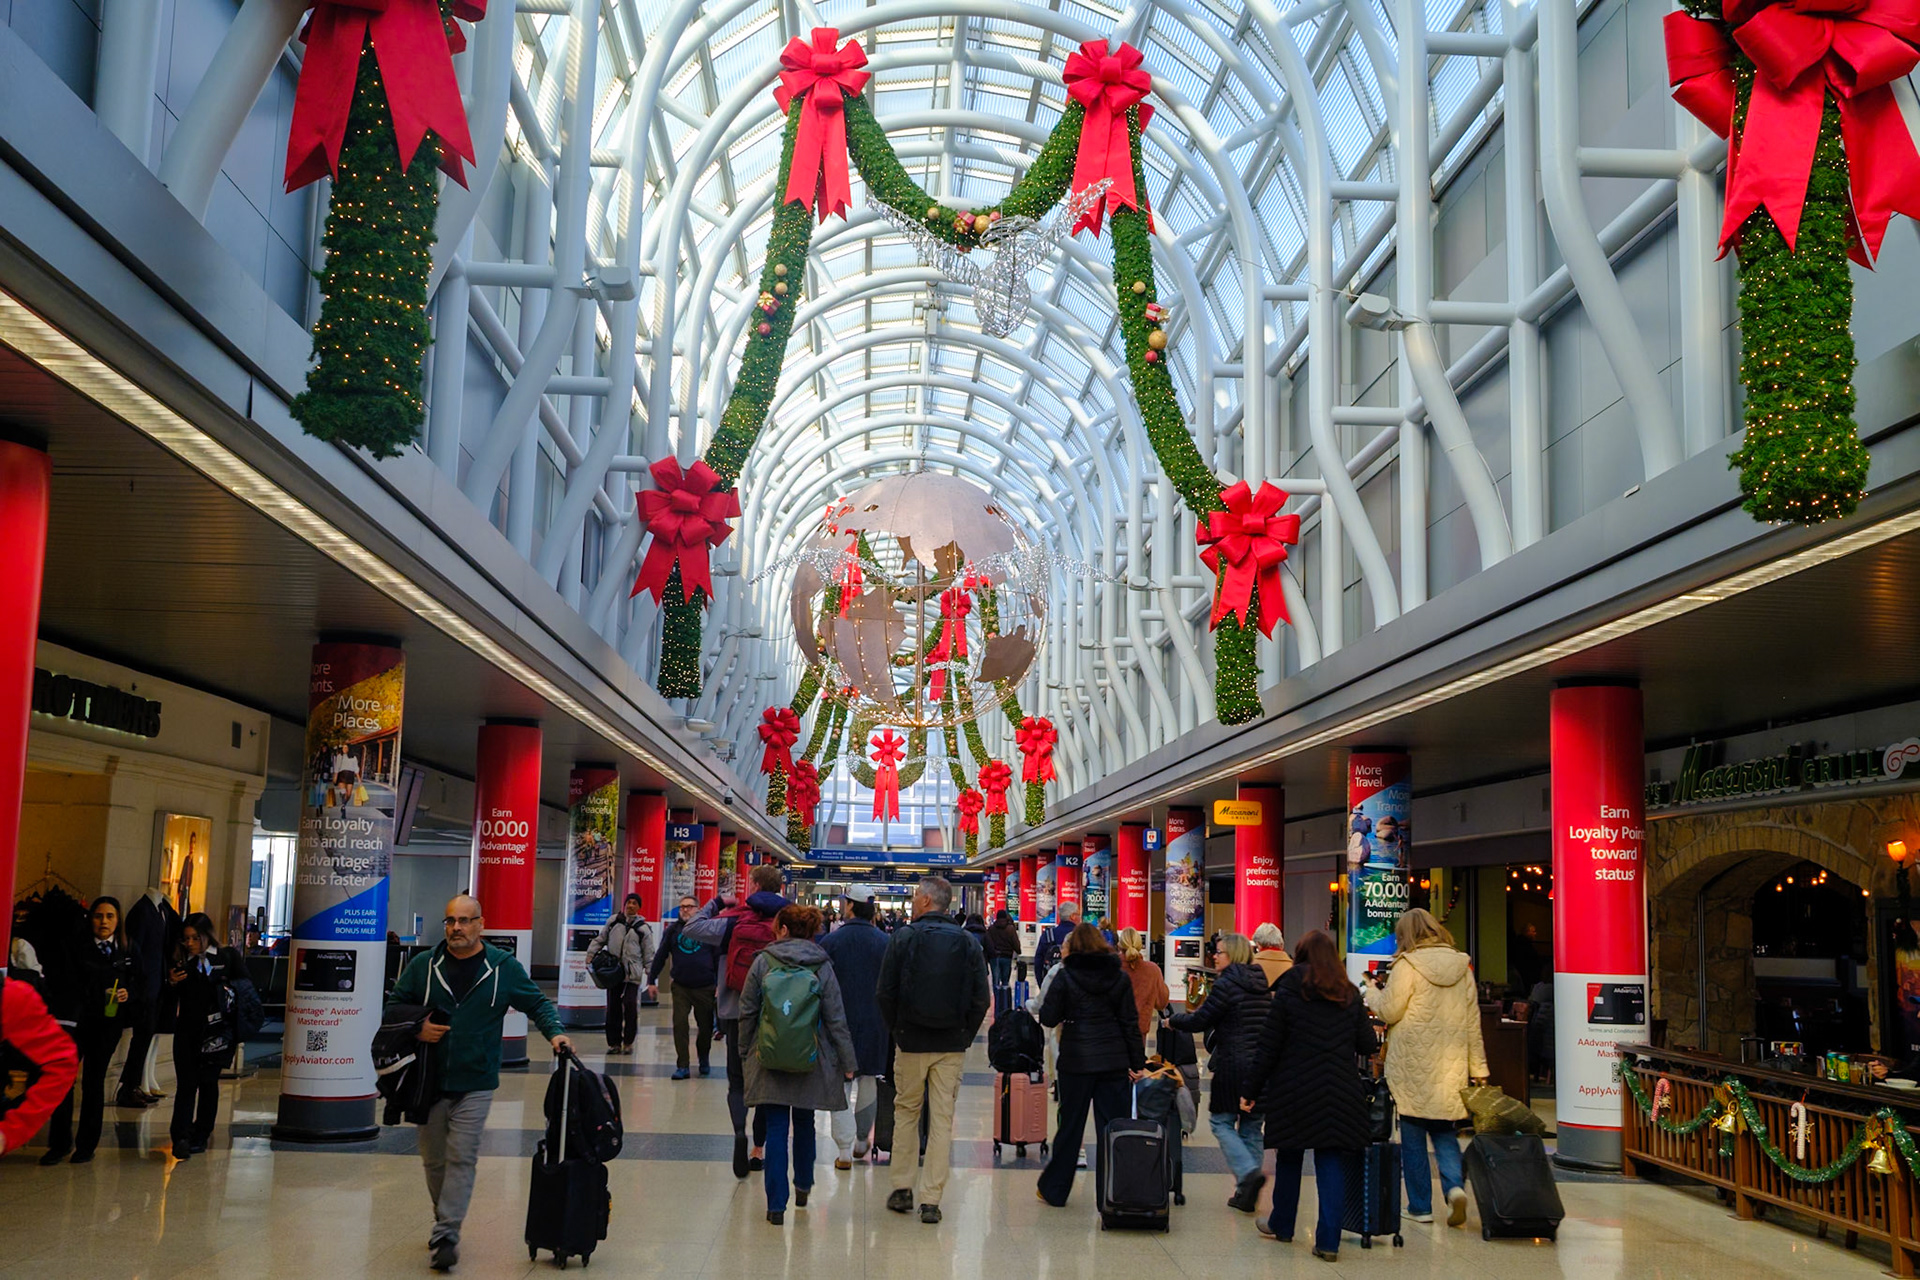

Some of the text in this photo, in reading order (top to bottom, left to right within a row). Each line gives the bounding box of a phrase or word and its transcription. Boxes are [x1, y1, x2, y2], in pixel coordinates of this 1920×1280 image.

[312, 663, 331, 675] ore
[338, 695, 381, 712] More
[333, 713, 382, 730] Places.
[1355, 764, 1382, 775] More
[1673, 742, 1796, 801] Macaroni
[1803, 749, 1880, 784] GRILL
[1355, 776, 1385, 788] Travel.
[586, 796, 609, 804] More
[492, 807, 512, 817] Earn
[1219, 806, 1260, 818] Macaroni
[1600, 805, 1630, 819] Earn
[325, 816, 375, 835] Loyalty
[673, 827, 690, 838] H3
[1569, 825, 1645, 843] Loyalty Point
[321, 835, 347, 848] and
[350, 837, 383, 850] reach
[1590, 847, 1638, 860] toward
[300, 853, 370, 872] Advantage
[502, 855, 525, 866] miles
[1065, 856, 1079, 866] K2
[1253, 856, 1274, 866] Enjoy
[694, 868, 716, 878] 0,000
[1246, 867, 1279, 876] preferred
[1381, 873, 1400, 881] Earn
[1247, 877, 1279, 888] boarding
[1363, 881, 1410, 900] 70,000
[1365, 899, 1409, 910] AAdvantag
[1367, 908, 1392, 918] bonus
[333, 918, 377, 926] AADVANTAGE
[335, 927, 377, 935] BONUS MILES
[329, 1007, 359, 1016] Aviator
[296, 1017, 339, 1026] Mastercard
[1578, 1038, 1618, 1047] AAdvanta
[1597, 1050, 1621, 1058] Maste
[1578, 1085, 1621, 1097] ApplyAvi
